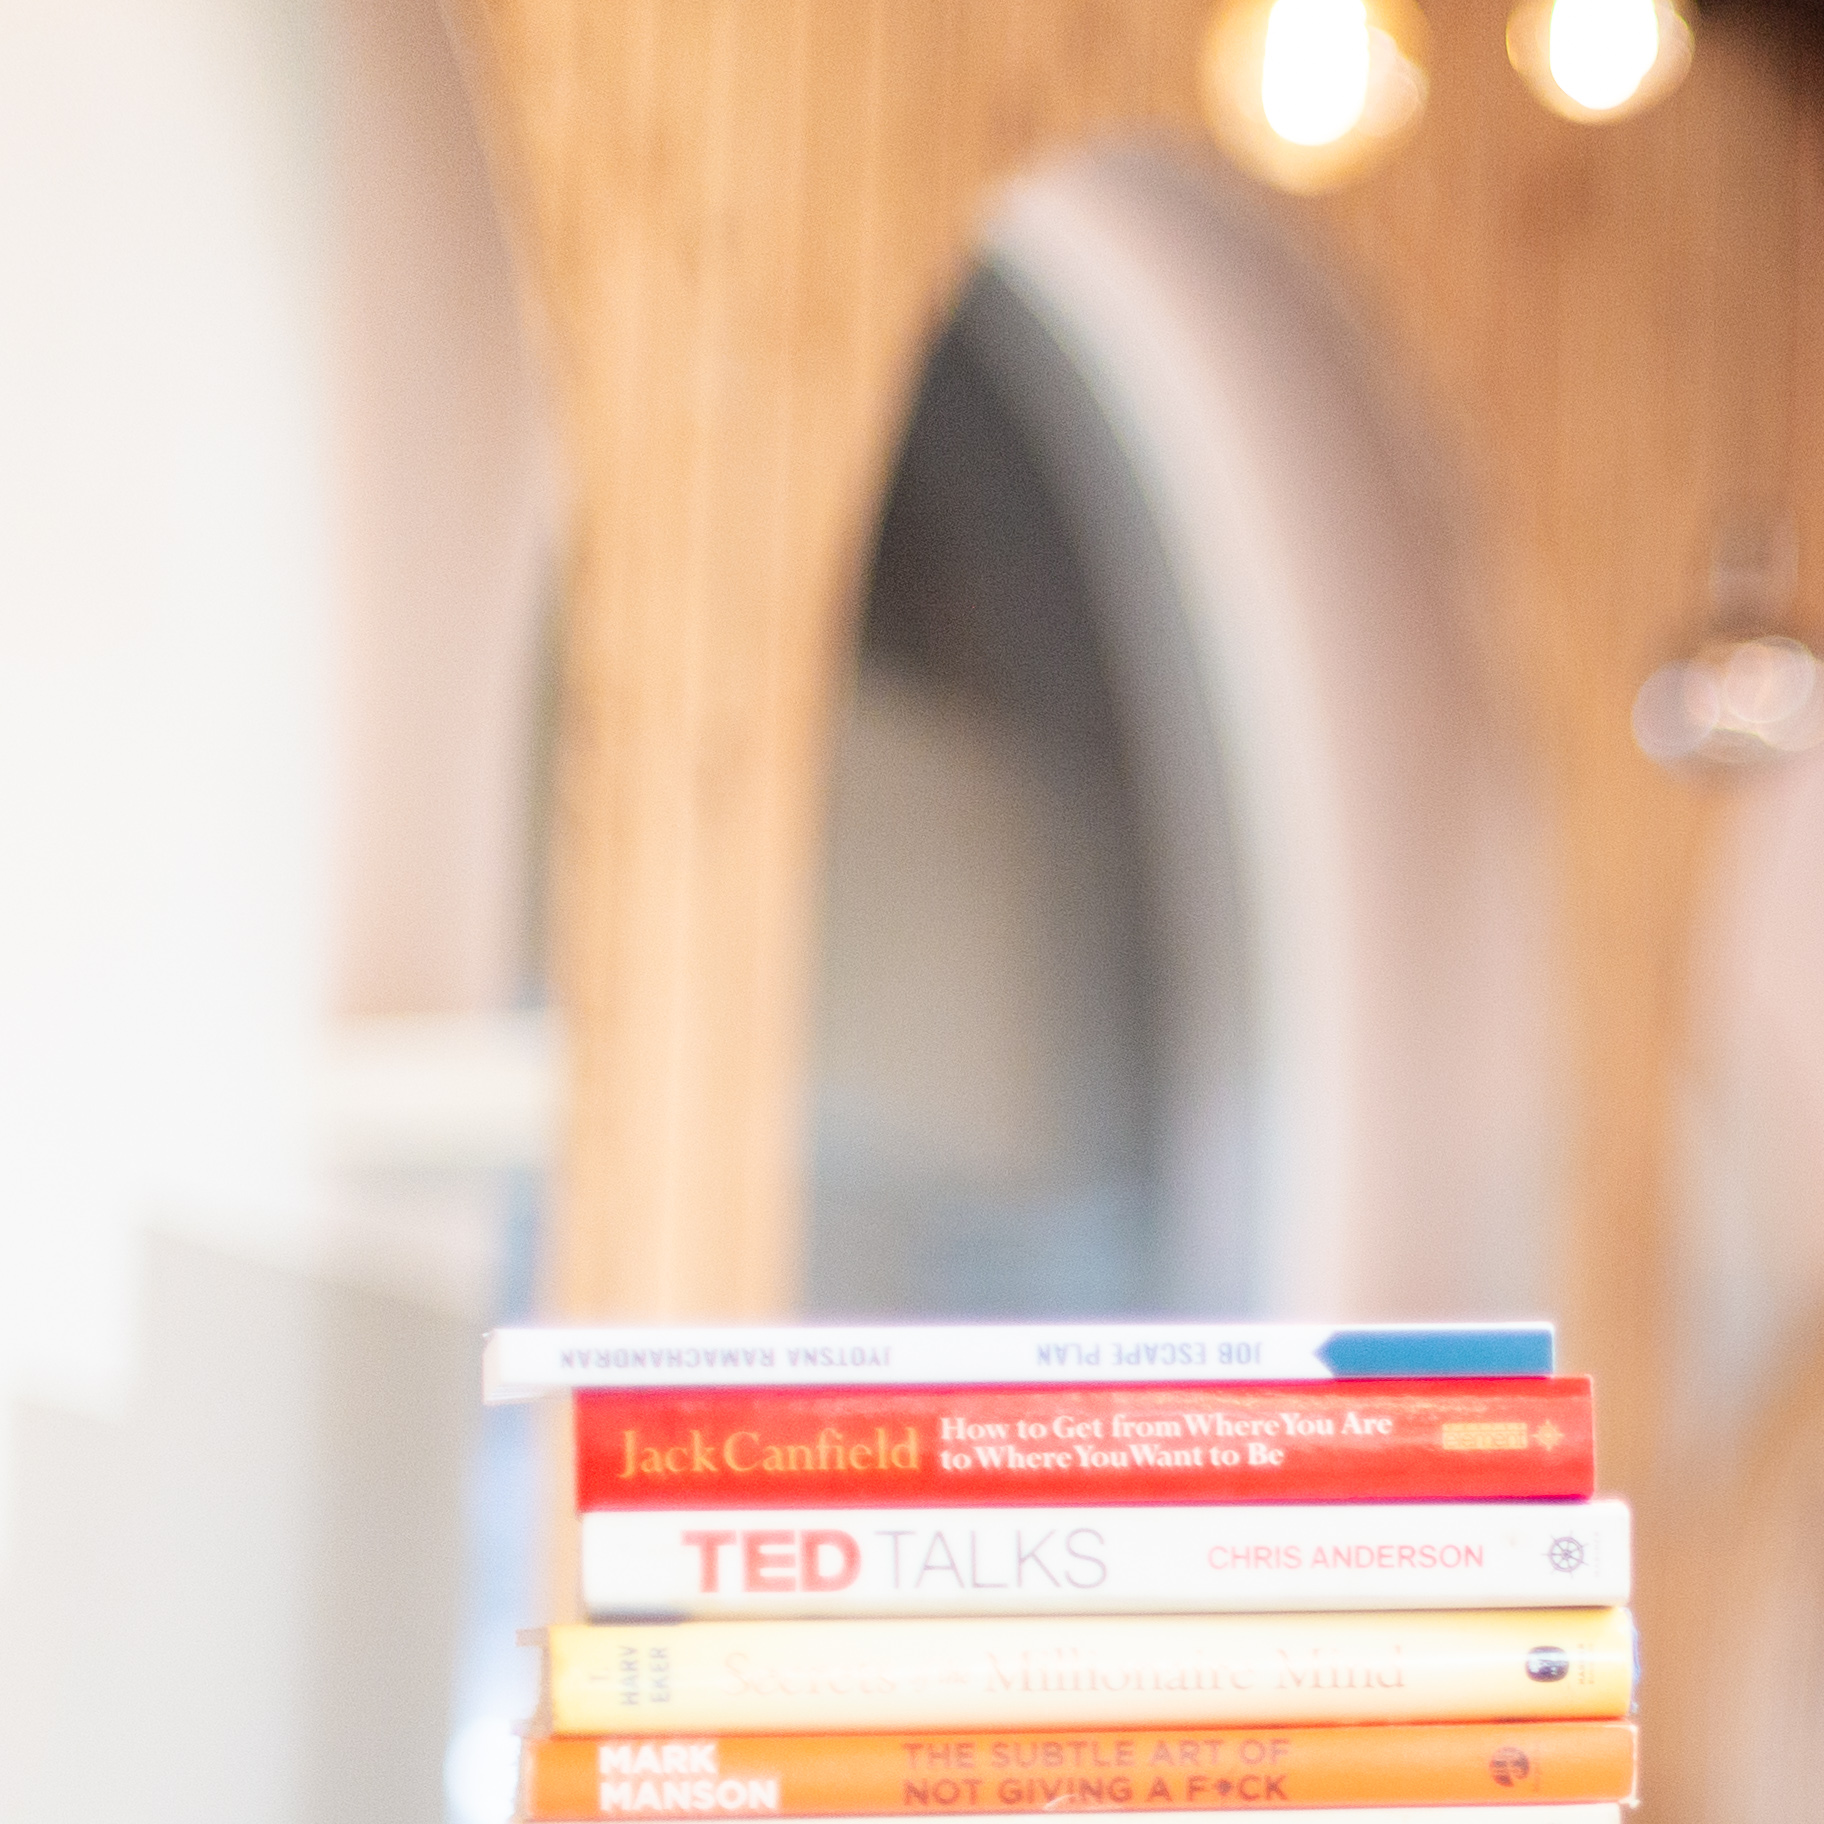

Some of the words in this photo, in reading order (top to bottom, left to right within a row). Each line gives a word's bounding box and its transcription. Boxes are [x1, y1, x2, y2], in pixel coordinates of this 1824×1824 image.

[560, 1346, 776, 1369] RAMACHANDRAN
[787, 1345, 892, 1368] JYOTSNA
[1037, 1342, 1101, 1367] PLAN
[1113, 1341, 1207, 1367] ESCAPE
[1218, 1340, 1262, 1366] JOB
[940, 1416, 1010, 1441] How
[1017, 1419, 1048, 1439] to
[1052, 1415, 1104, 1439] Get
[1111, 1413, 1182, 1438] from
[1183, 1412, 1281, 1437] Where
[1279, 1412, 1335, 1436] You
[1341, 1411, 1394, 1435] Are
[619, 1429, 718, 1479] Jack
[723, 1426, 920, 1473] Canfield
[940, 1449, 973, 1471] to
[971, 1445, 1072, 1470] Where
[1072, 1445, 1128, 1468] You
[1128, 1444, 1204, 1468] Want
[1209, 1446, 1241, 1467] to
[1247, 1442, 1285, 1466] Be
[681, 1529, 863, 1594] TED
[874, 1527, 1107, 1590] TALKS
[1207, 1545, 1302, 1570] CHRIS
[1310, 1543, 1485, 1570] ANDERSON
[618, 1645, 640, 1706] HARV
[648, 1646, 671, 1703] EKER
[984, 1647, 1255, 1694] Millionaire
[1277, 1645, 1406, 1692] Mind
[599, 1742, 717, 1776] MARK
[904, 1741, 976, 1769] THE
[990, 1739, 1135, 1769] SUBTLE
[1148, 1739, 1222, 1767] ART
[1237, 1738, 1290, 1766] OF
[599, 1778, 779, 1811] MANSON
[903, 1778, 980, 1806] NOT
[1000, 1776, 1133, 1806] GIVING
[1147, 1776, 1173, 1803] A
